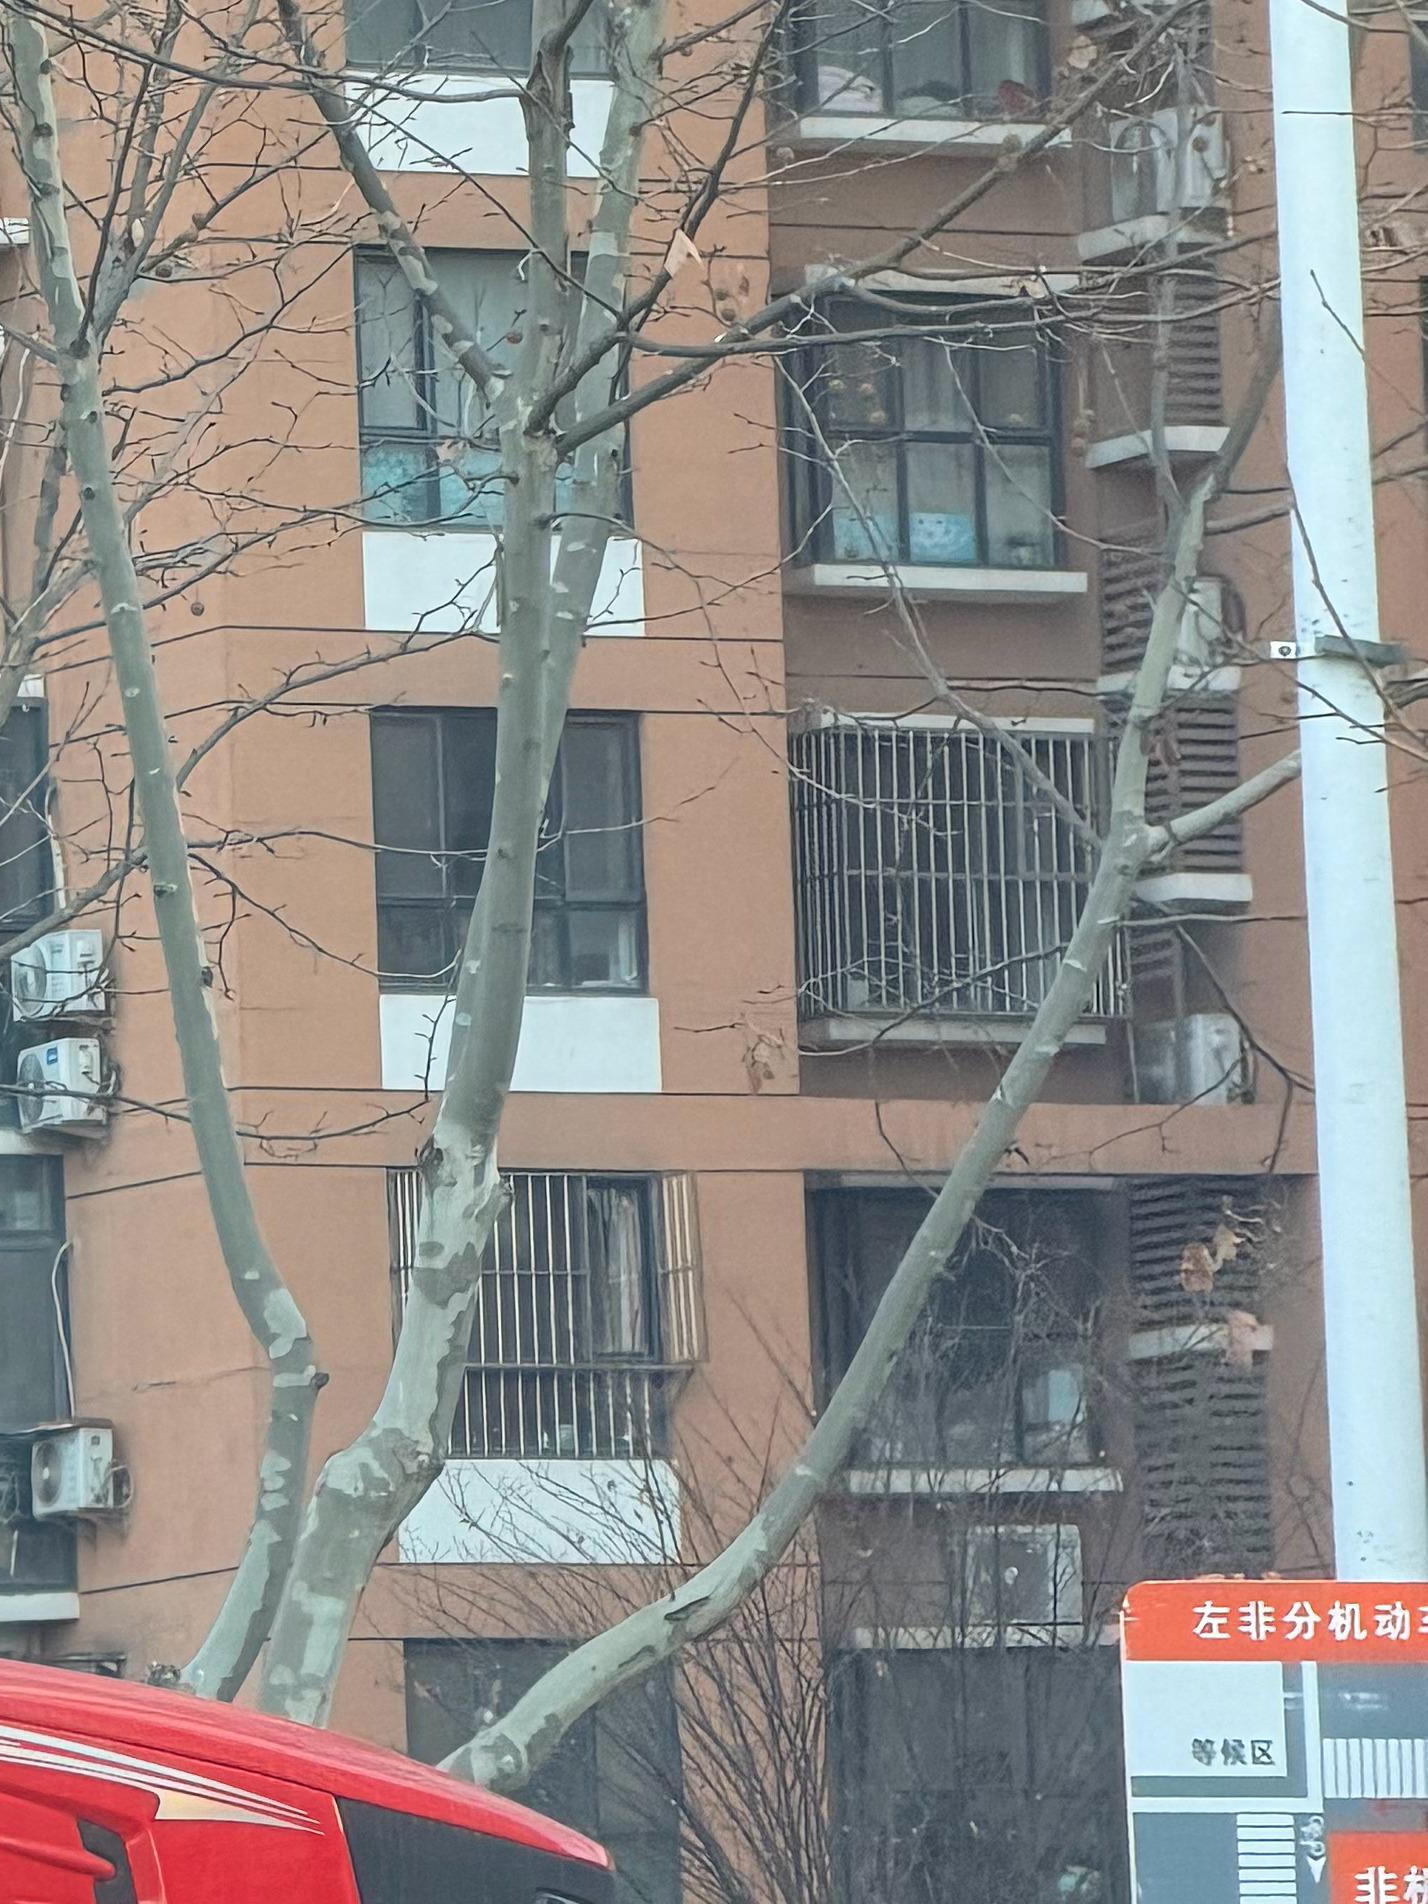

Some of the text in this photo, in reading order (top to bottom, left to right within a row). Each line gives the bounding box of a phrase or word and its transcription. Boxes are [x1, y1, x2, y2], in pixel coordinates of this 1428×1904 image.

[1192, 1600, 1428, 1641] 左非分机动
[1191, 1738, 1276, 1766] 等候区
